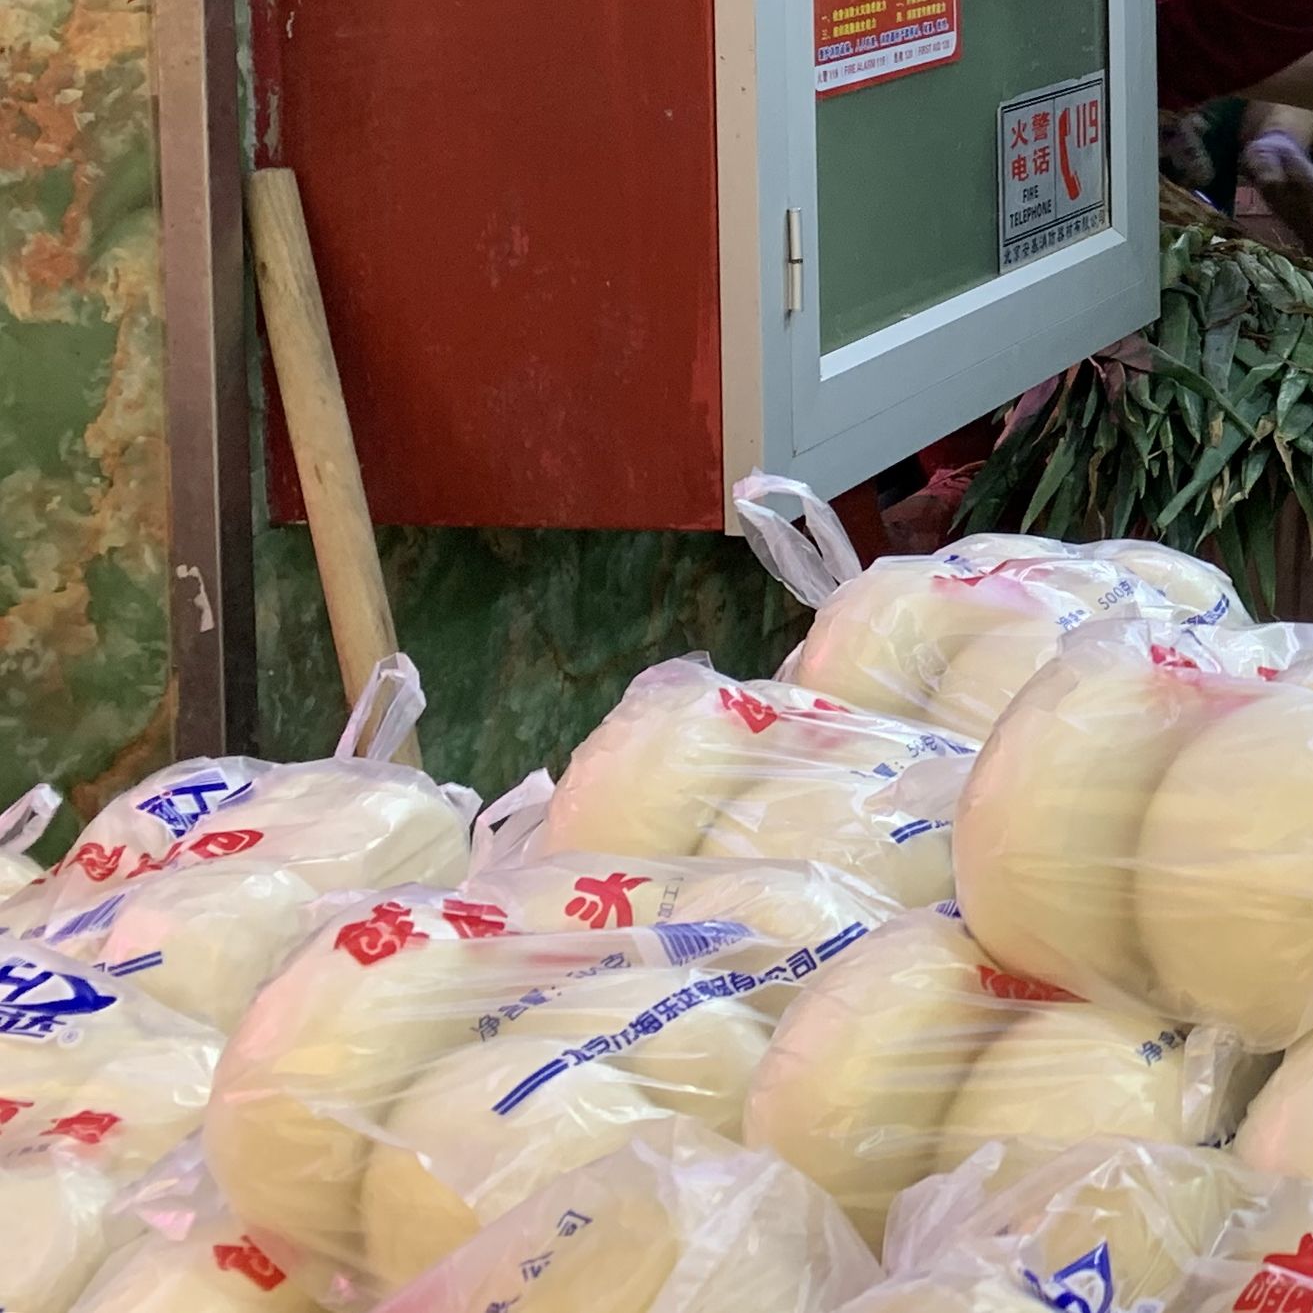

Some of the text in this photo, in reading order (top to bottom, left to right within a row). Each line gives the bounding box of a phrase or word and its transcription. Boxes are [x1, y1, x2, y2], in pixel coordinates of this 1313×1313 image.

[1011, 111, 1051, 149] 火警
[1076, 99, 1100, 149] 119
[1011, 145, 1051, 182] 电话
[1022, 185, 1039, 204] FIRE
[1009, 199, 1052, 229] TELEPHONE
